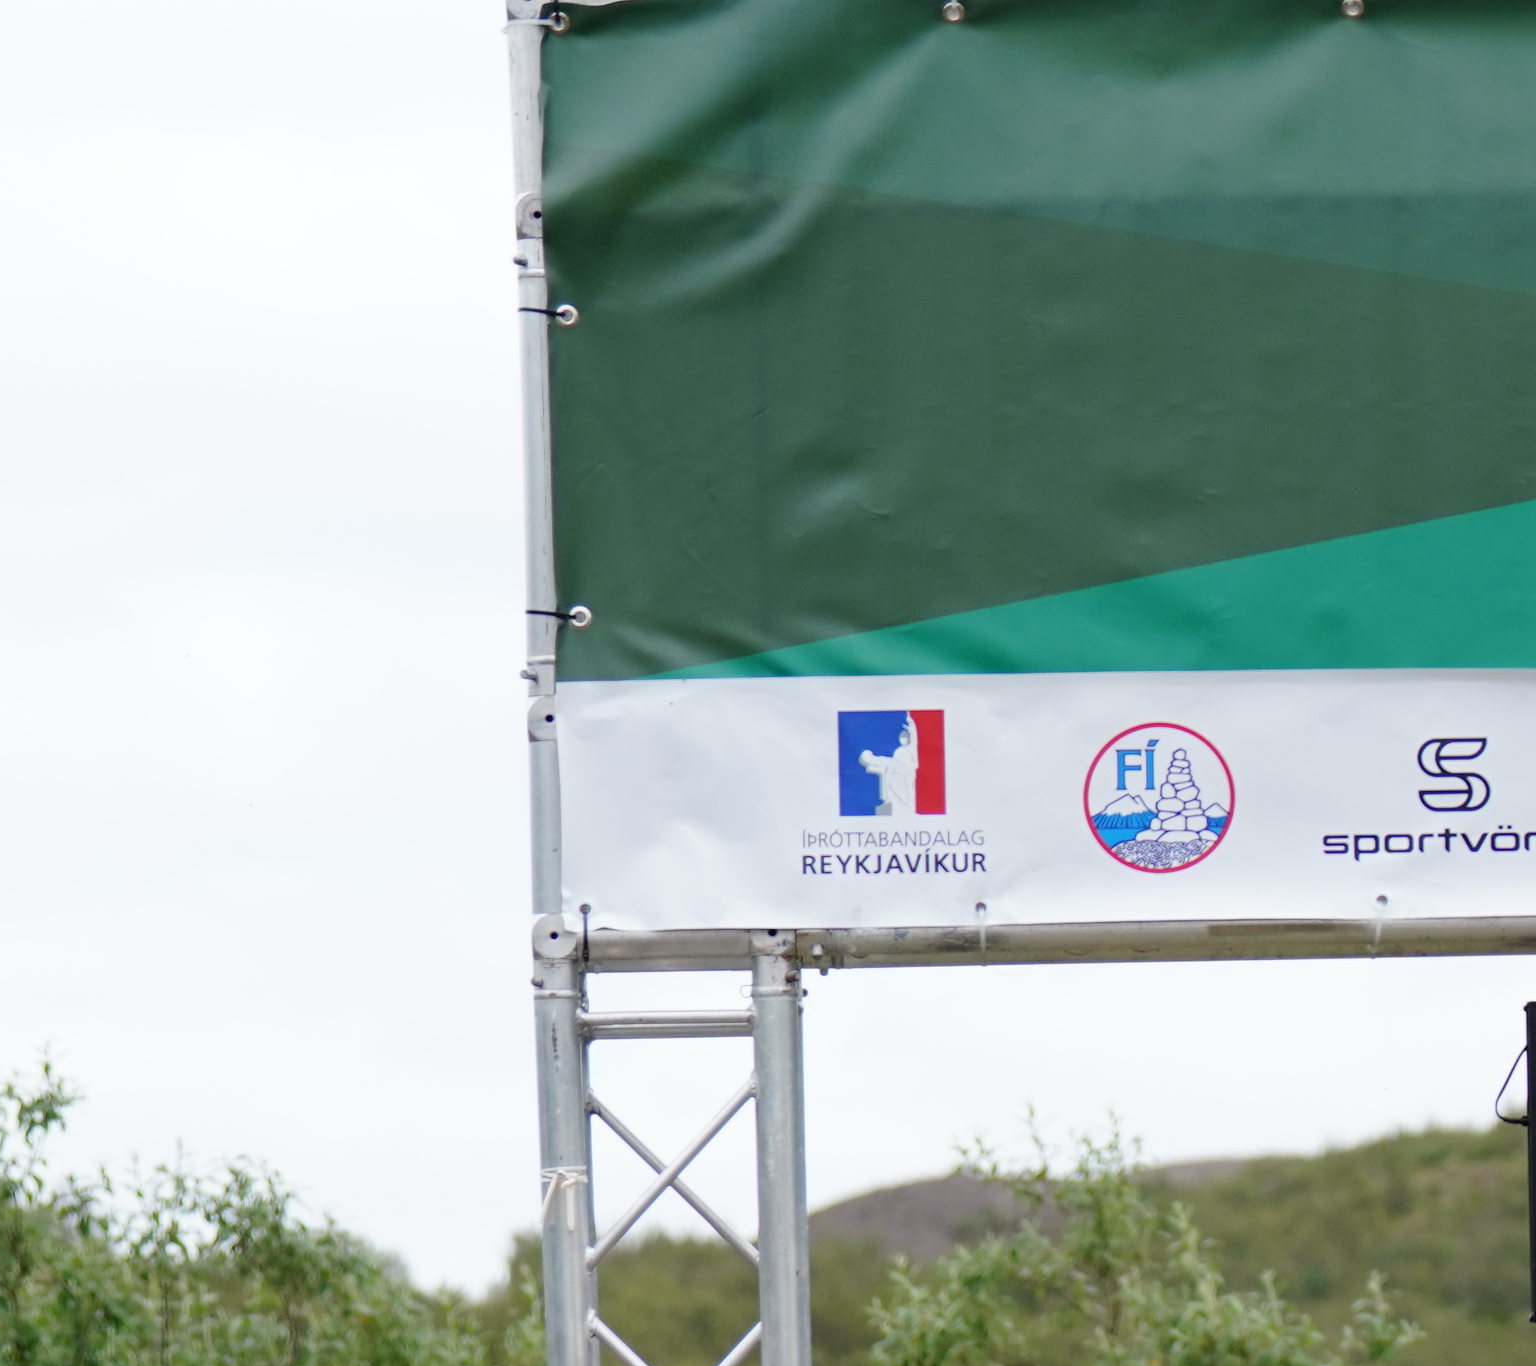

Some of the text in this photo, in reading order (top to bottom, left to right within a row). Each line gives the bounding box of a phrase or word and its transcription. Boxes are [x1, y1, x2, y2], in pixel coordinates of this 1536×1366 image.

[1115, 739, 1160, 791] FÍ
[801, 828, 986, 849] ÍÞRÓTTABANDALAG
[801, 848, 988, 875] REYKJAVÍKUR
